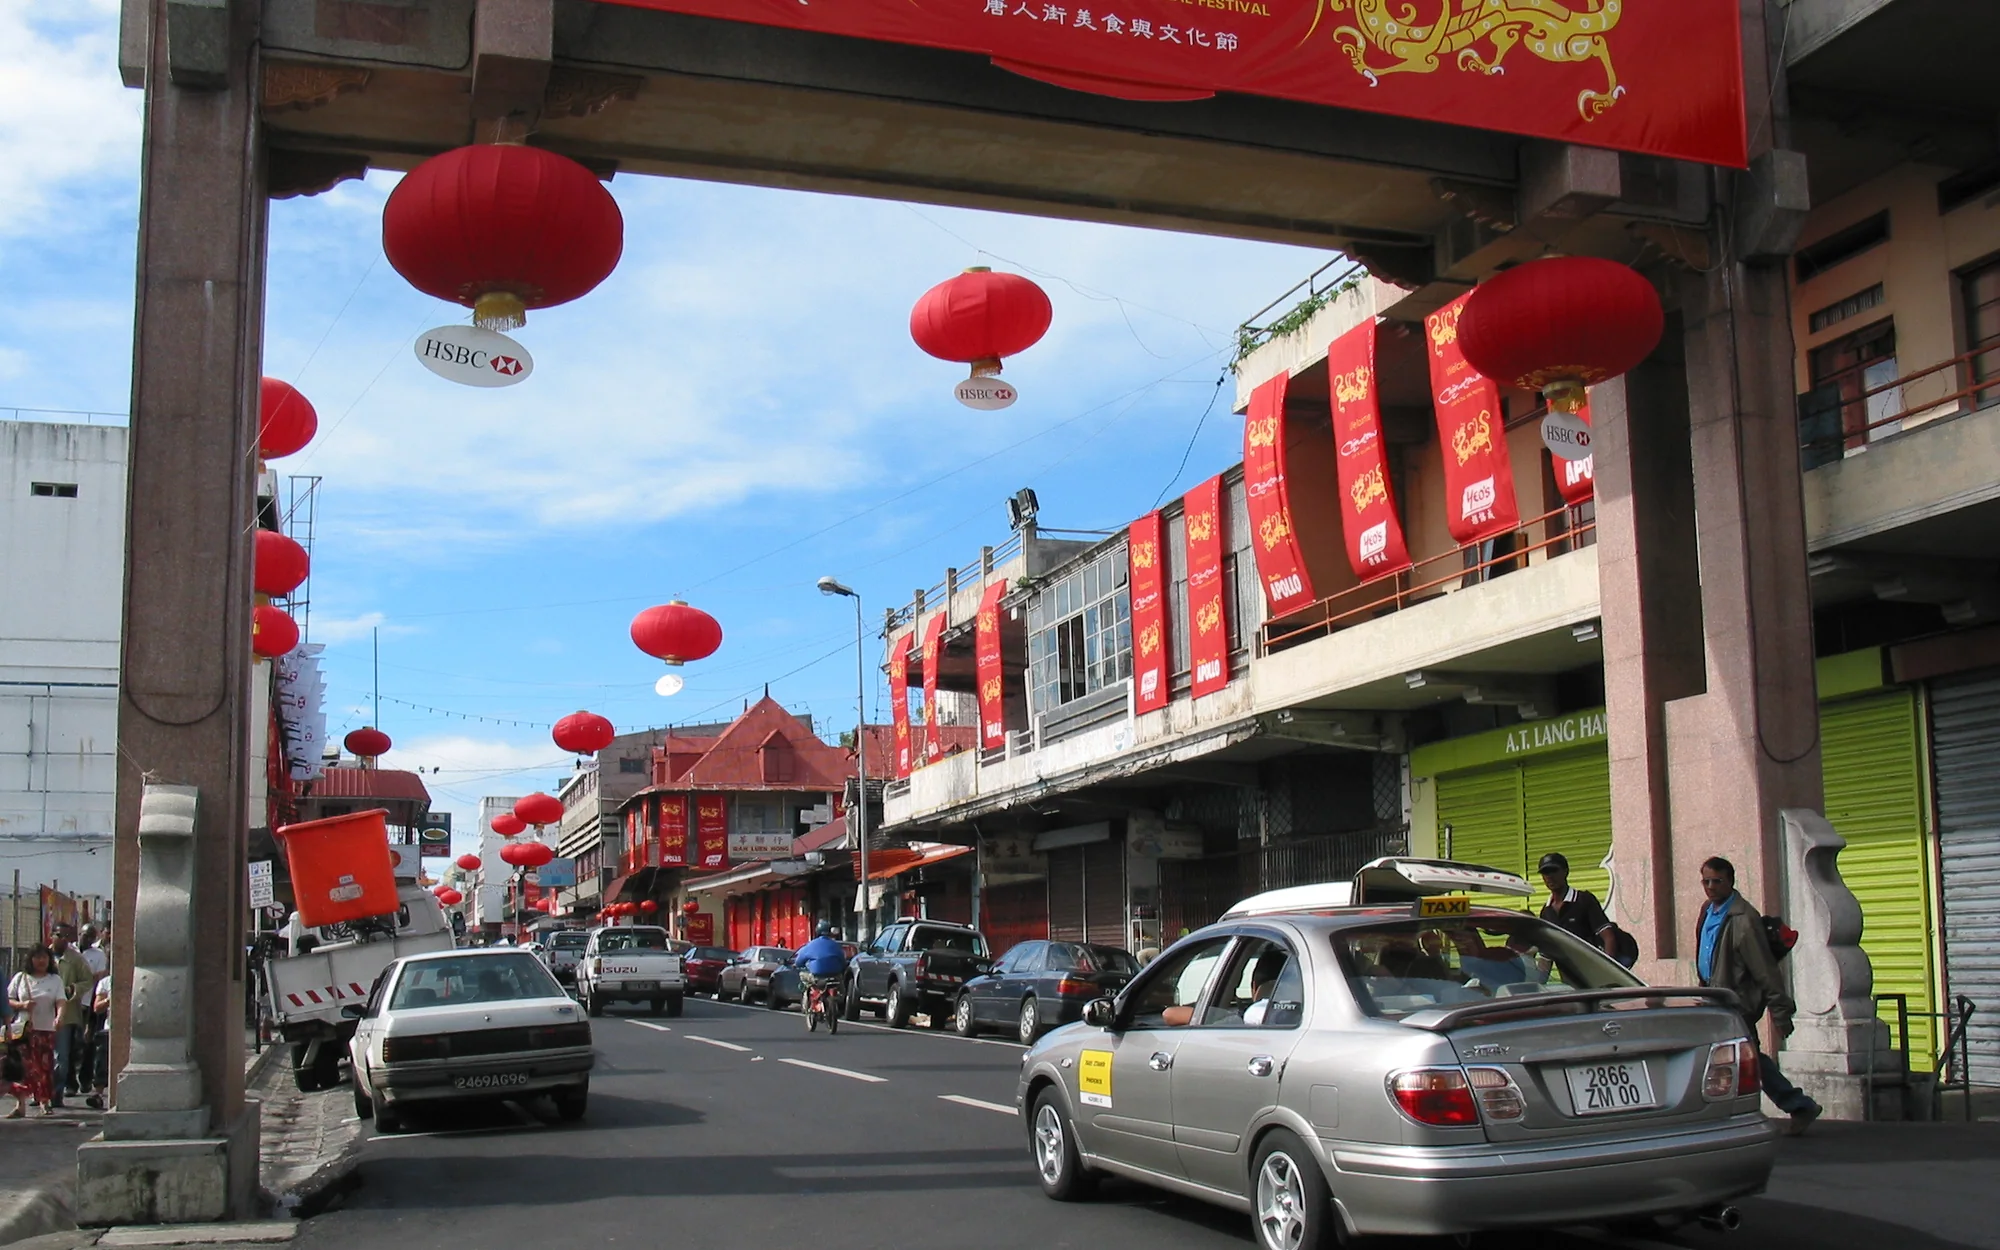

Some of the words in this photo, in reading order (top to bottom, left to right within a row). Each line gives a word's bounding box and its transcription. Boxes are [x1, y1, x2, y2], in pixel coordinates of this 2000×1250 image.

[983, 0, 1239, 52] 唐人街美食與文化節
[424, 339, 487, 369] HSBC
[960, 388, 993, 400] HSBC
[1546, 425, 1574, 444] HSBC
[1270, 573, 1303, 602] APOLLO
[1196, 658, 1220, 684] APOLLO
[1534, 719, 1575, 747] LANG
[1424, 900, 1467, 914] TAXI
[602, 966, 638, 974] ISUZU
[1586, 1064, 1630, 1087] 2866
[1585, 1086, 1615, 1109] ZM
[1619, 1084, 1640, 1105] 00
